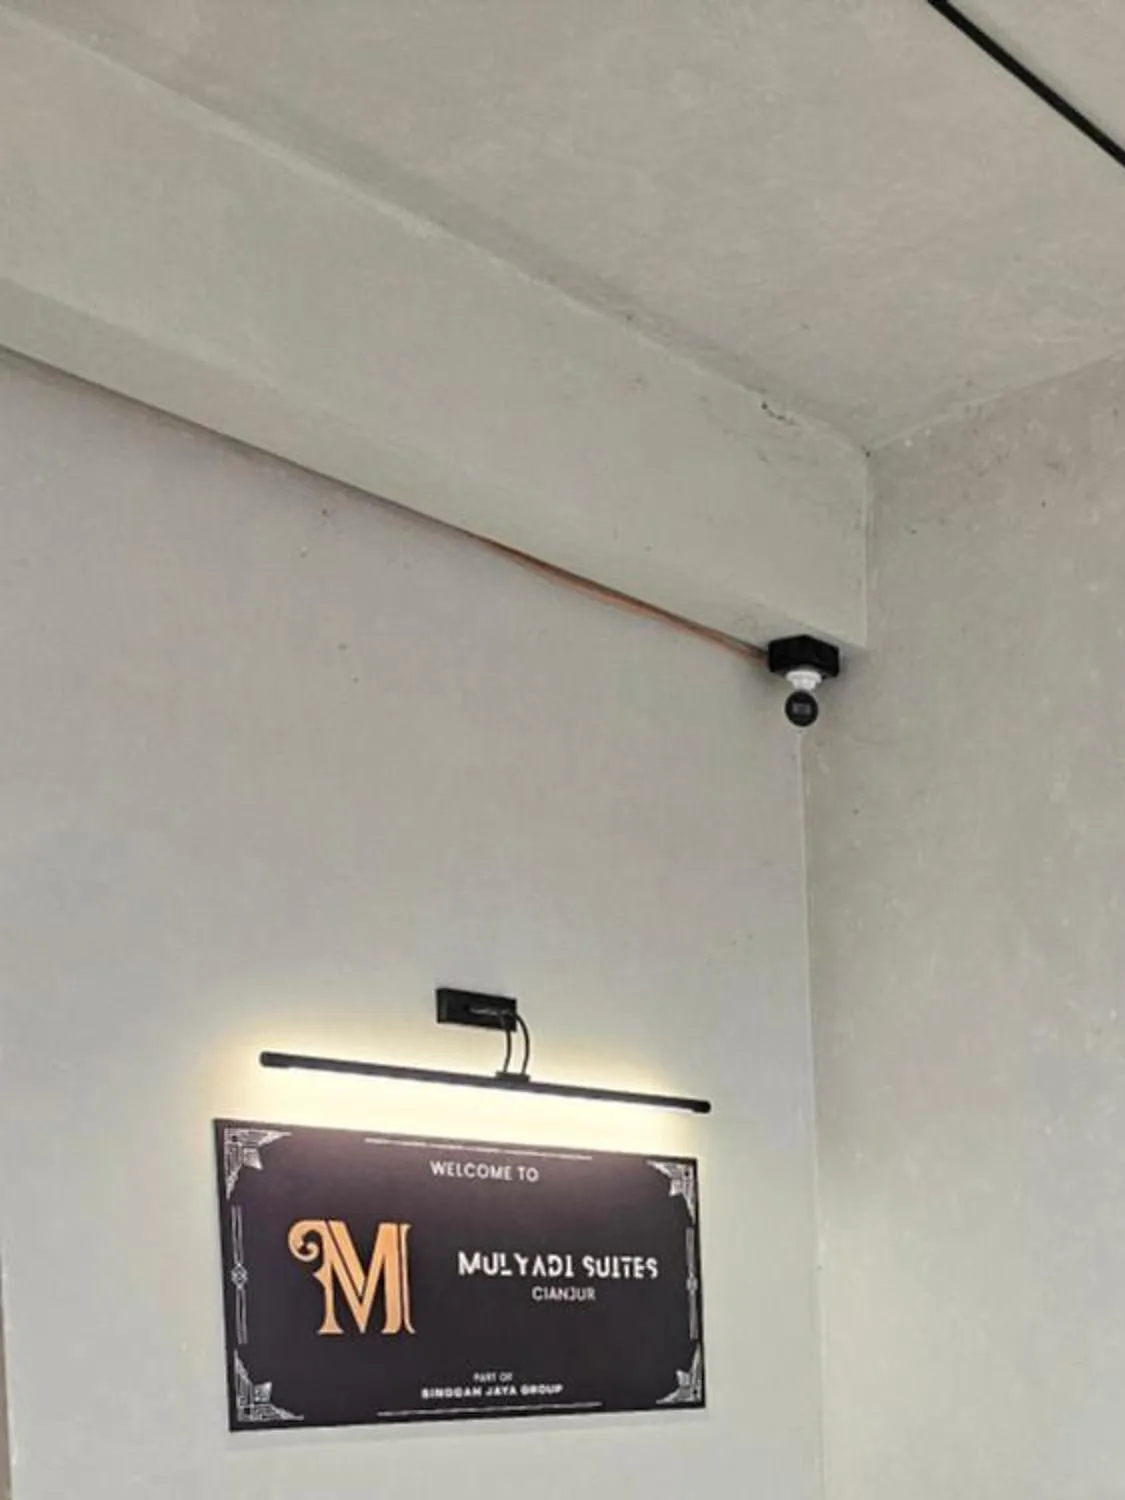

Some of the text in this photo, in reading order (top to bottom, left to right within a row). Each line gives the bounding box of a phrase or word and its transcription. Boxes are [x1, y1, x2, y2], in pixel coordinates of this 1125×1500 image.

[429, 1160, 540, 1182] WELCOME TO
[458, 1251, 659, 1279] MULYADI SUITES
[288, 1219, 416, 1335] M
[531, 1285, 597, 1301] CIANJUR
[473, 1371, 513, 1382] PART OF
[484, 1384, 518, 1396] JAYA
[519, 1383, 563, 1396] GROUP
